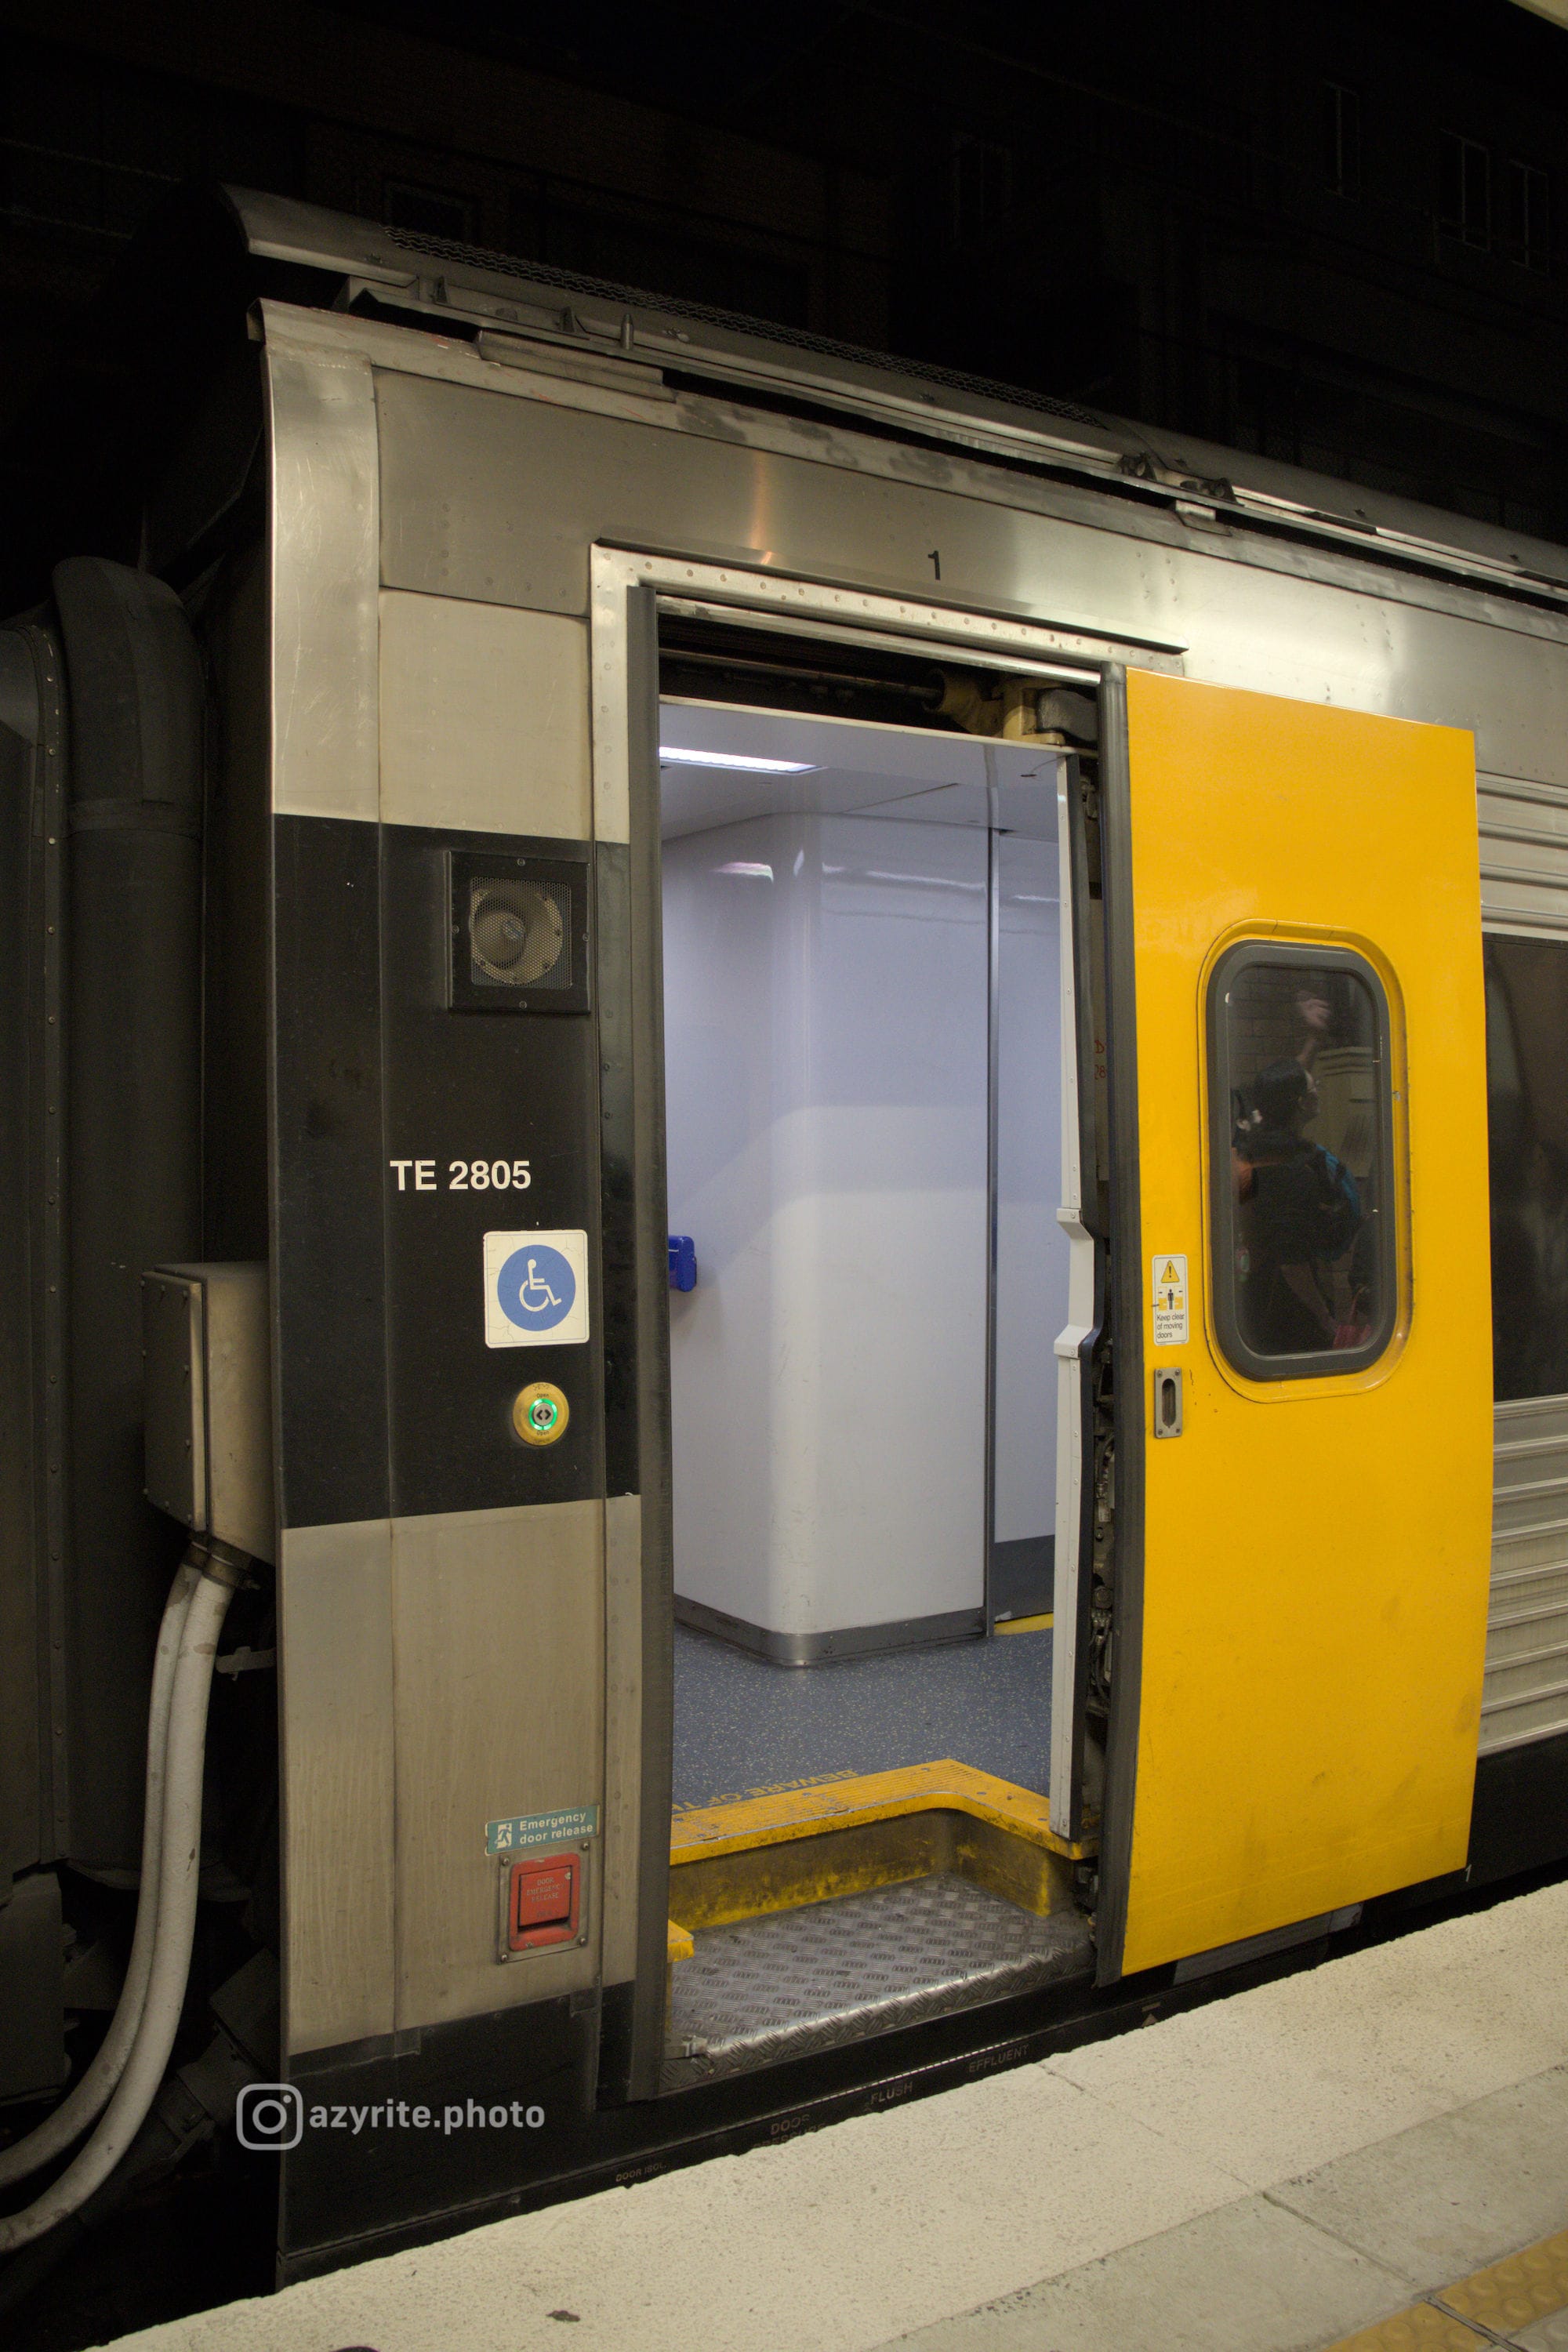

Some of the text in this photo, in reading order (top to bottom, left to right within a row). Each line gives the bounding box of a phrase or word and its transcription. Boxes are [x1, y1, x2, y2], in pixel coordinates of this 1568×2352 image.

[927, 550, 941, 580] 1
[390, 1160, 531, 1190] TE 2805
[746, 1769, 858, 1796] BEWARE
[707, 1793, 742, 1806] OF
[519, 1812, 586, 1831] Emergency
[519, 1823, 593, 1845] door release
[526, 1883, 564, 1896] EMERGENCY
[537, 1877, 554, 1886] DOOR
[532, 1892, 559, 1903] RELEASE
[968, 2044, 1029, 2074] EFFLUENT
[870, 2081, 913, 2106] FLUSH
[615, 2169, 642, 2182] DOOR
